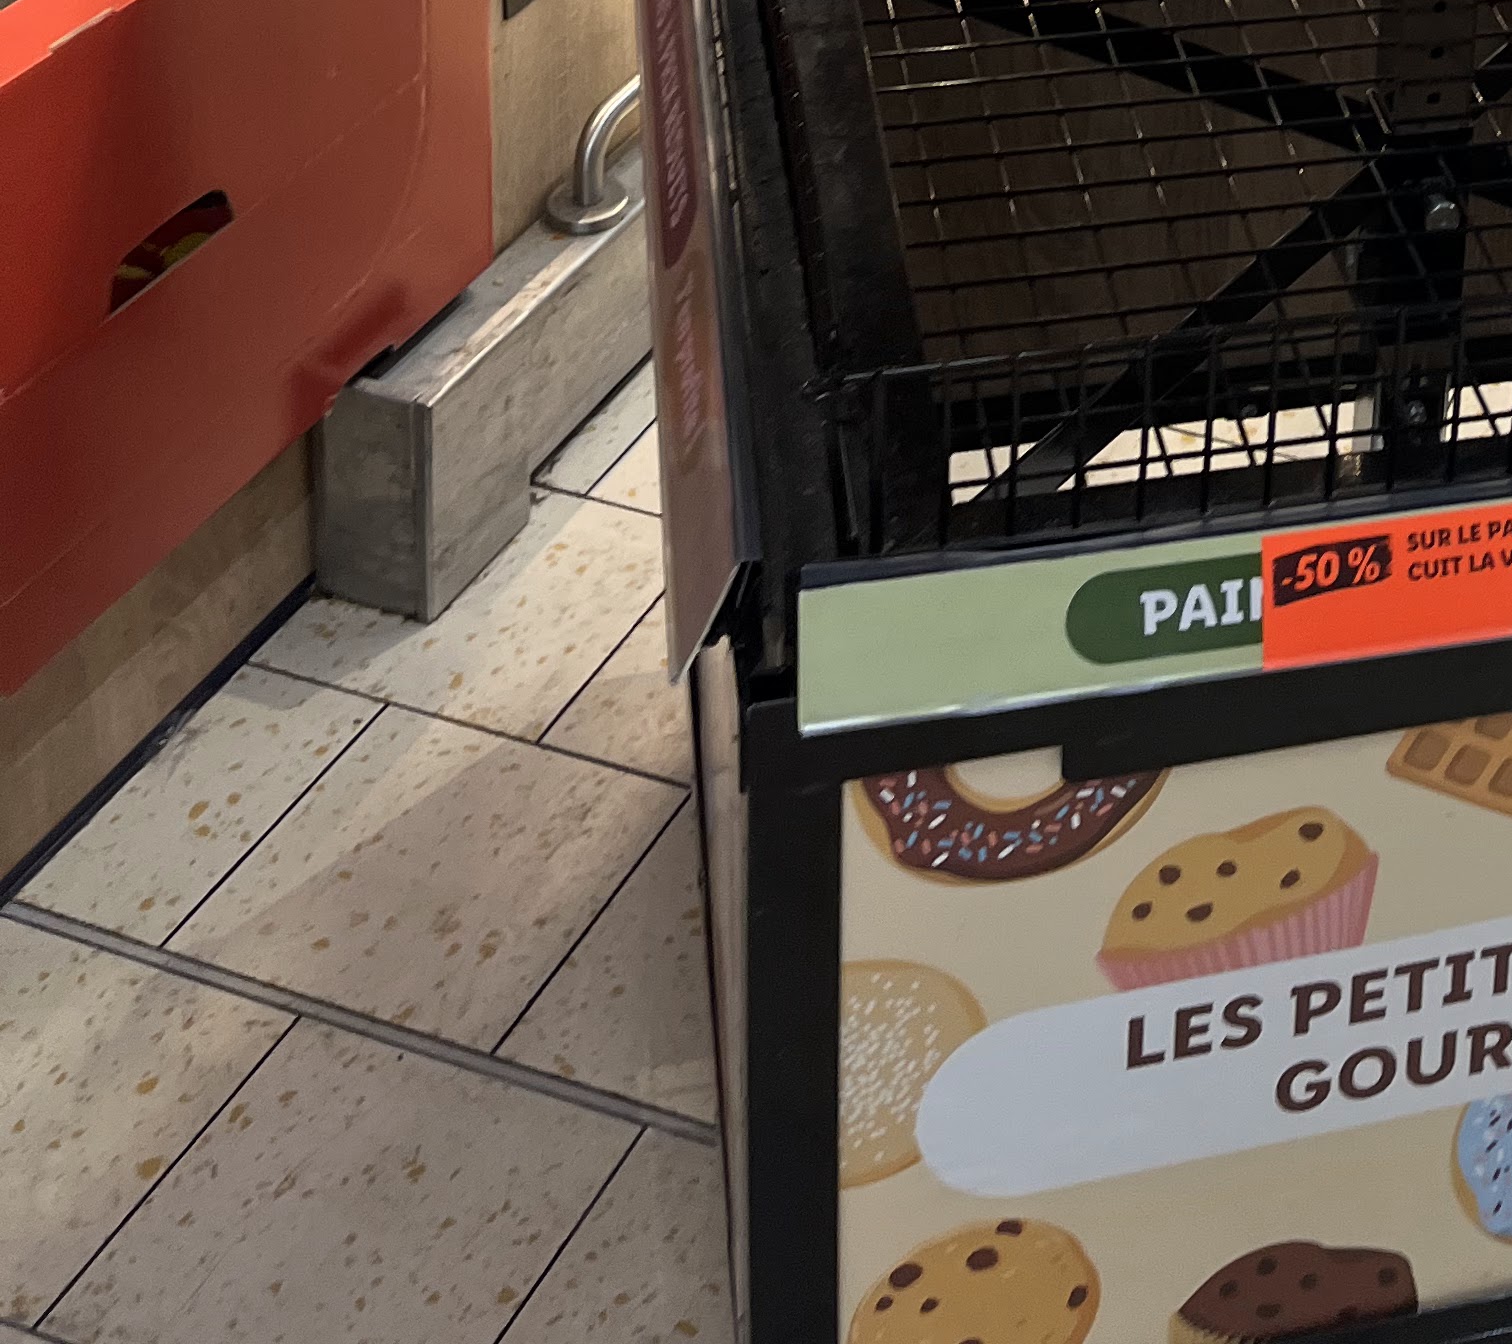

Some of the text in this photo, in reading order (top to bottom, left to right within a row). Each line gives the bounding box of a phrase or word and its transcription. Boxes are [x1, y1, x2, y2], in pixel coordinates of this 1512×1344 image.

[1407, 526, 1452, 552] SUR
[1458, 523, 1481, 545] LE
[1280, 543, 1381, 592] -50 %
[1408, 556, 1461, 582] CUIT
[1469, 551, 1496, 573] LA
[1124, 994, 1264, 1070] LES
